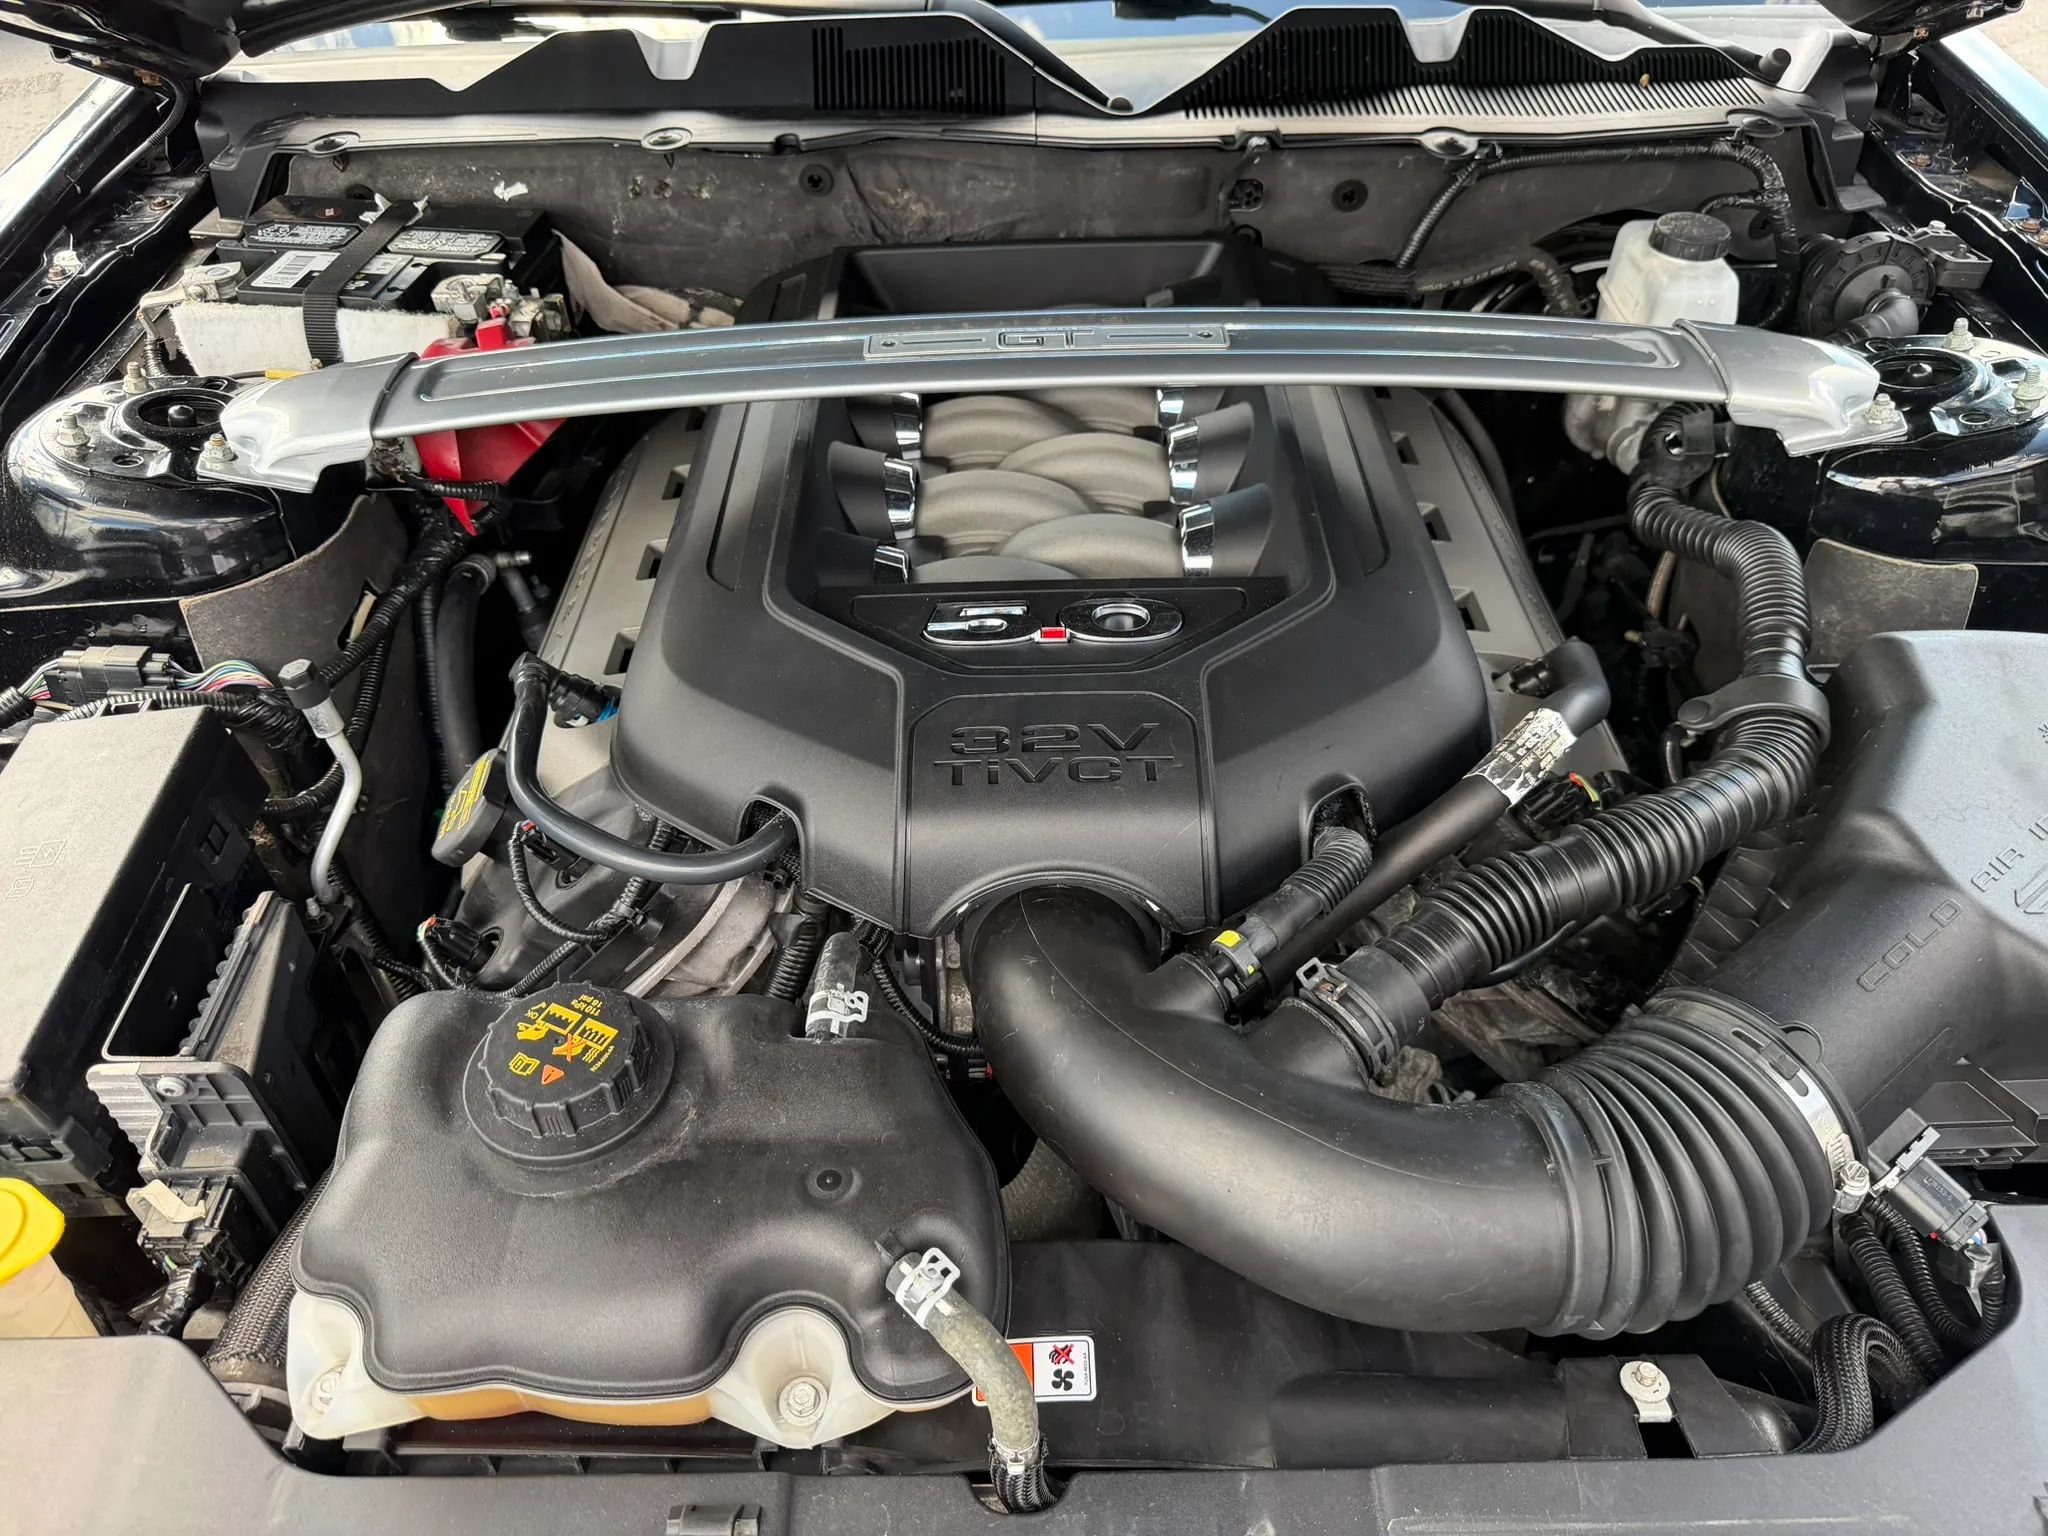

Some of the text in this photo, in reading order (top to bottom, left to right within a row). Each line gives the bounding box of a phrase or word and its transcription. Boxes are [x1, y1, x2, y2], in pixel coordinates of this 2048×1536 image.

[998, 330, 1095, 349] GT
[922, 598, 1185, 646] 5.0
[950, 723, 1160, 754] 32V
[933, 756, 1175, 785] TiVCT
[1856, 898, 1964, 993] COLD
[1971, 847, 2025, 893] AIR
[524, 1009, 539, 1020] OK
